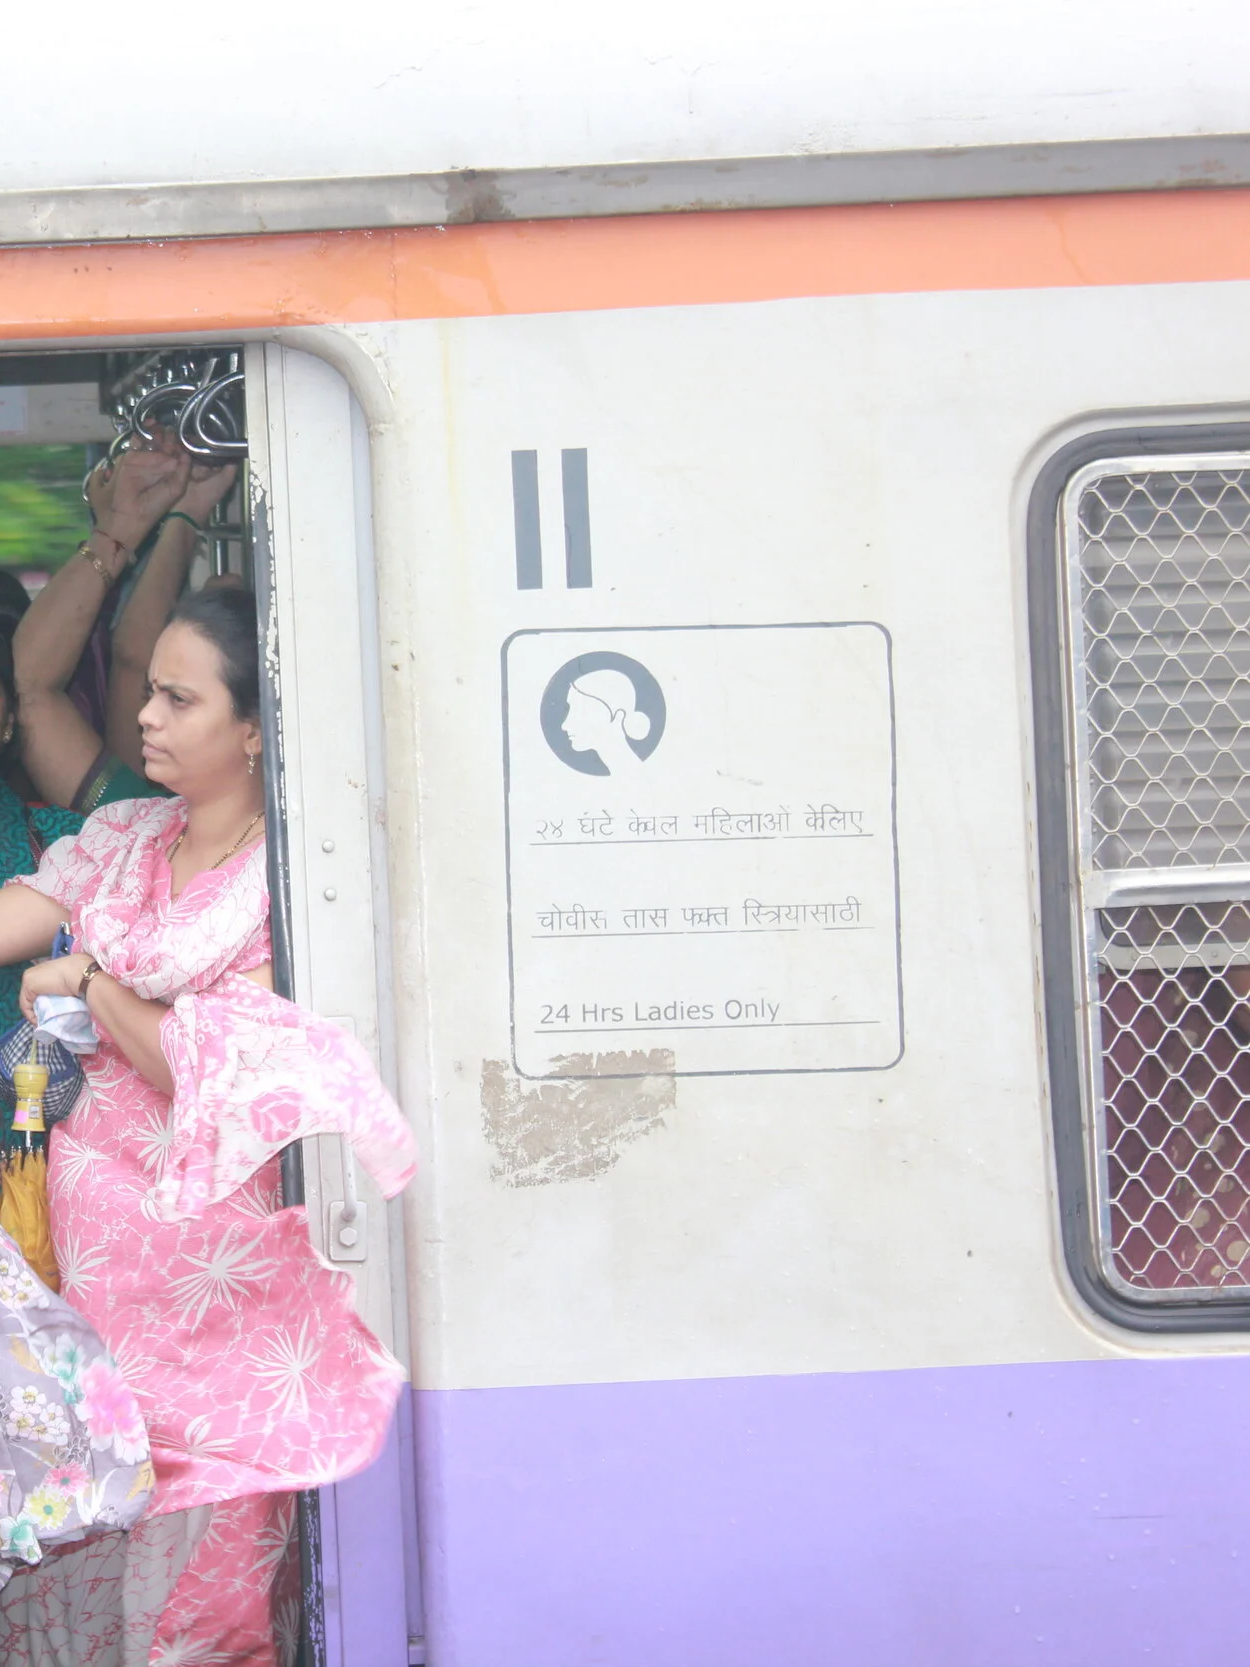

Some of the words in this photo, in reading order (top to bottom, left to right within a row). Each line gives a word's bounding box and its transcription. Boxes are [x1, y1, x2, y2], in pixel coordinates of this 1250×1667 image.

[535, 819, 564, 840] २४
[576, 808, 615, 837] घंटे
[626, 807, 679, 837] केवल
[692, 804, 793, 836] महिलाओं
[535, 902, 608, 931] चोवीस
[621, 907, 670, 929] तास
[680, 906, 731, 927] फक्त
[539, 1003, 571, 1025] 24
[581, 1002, 624, 1023] Hrs
[634, 1000, 715, 1022] Ladies
[724, 998, 781, 1022] Only
